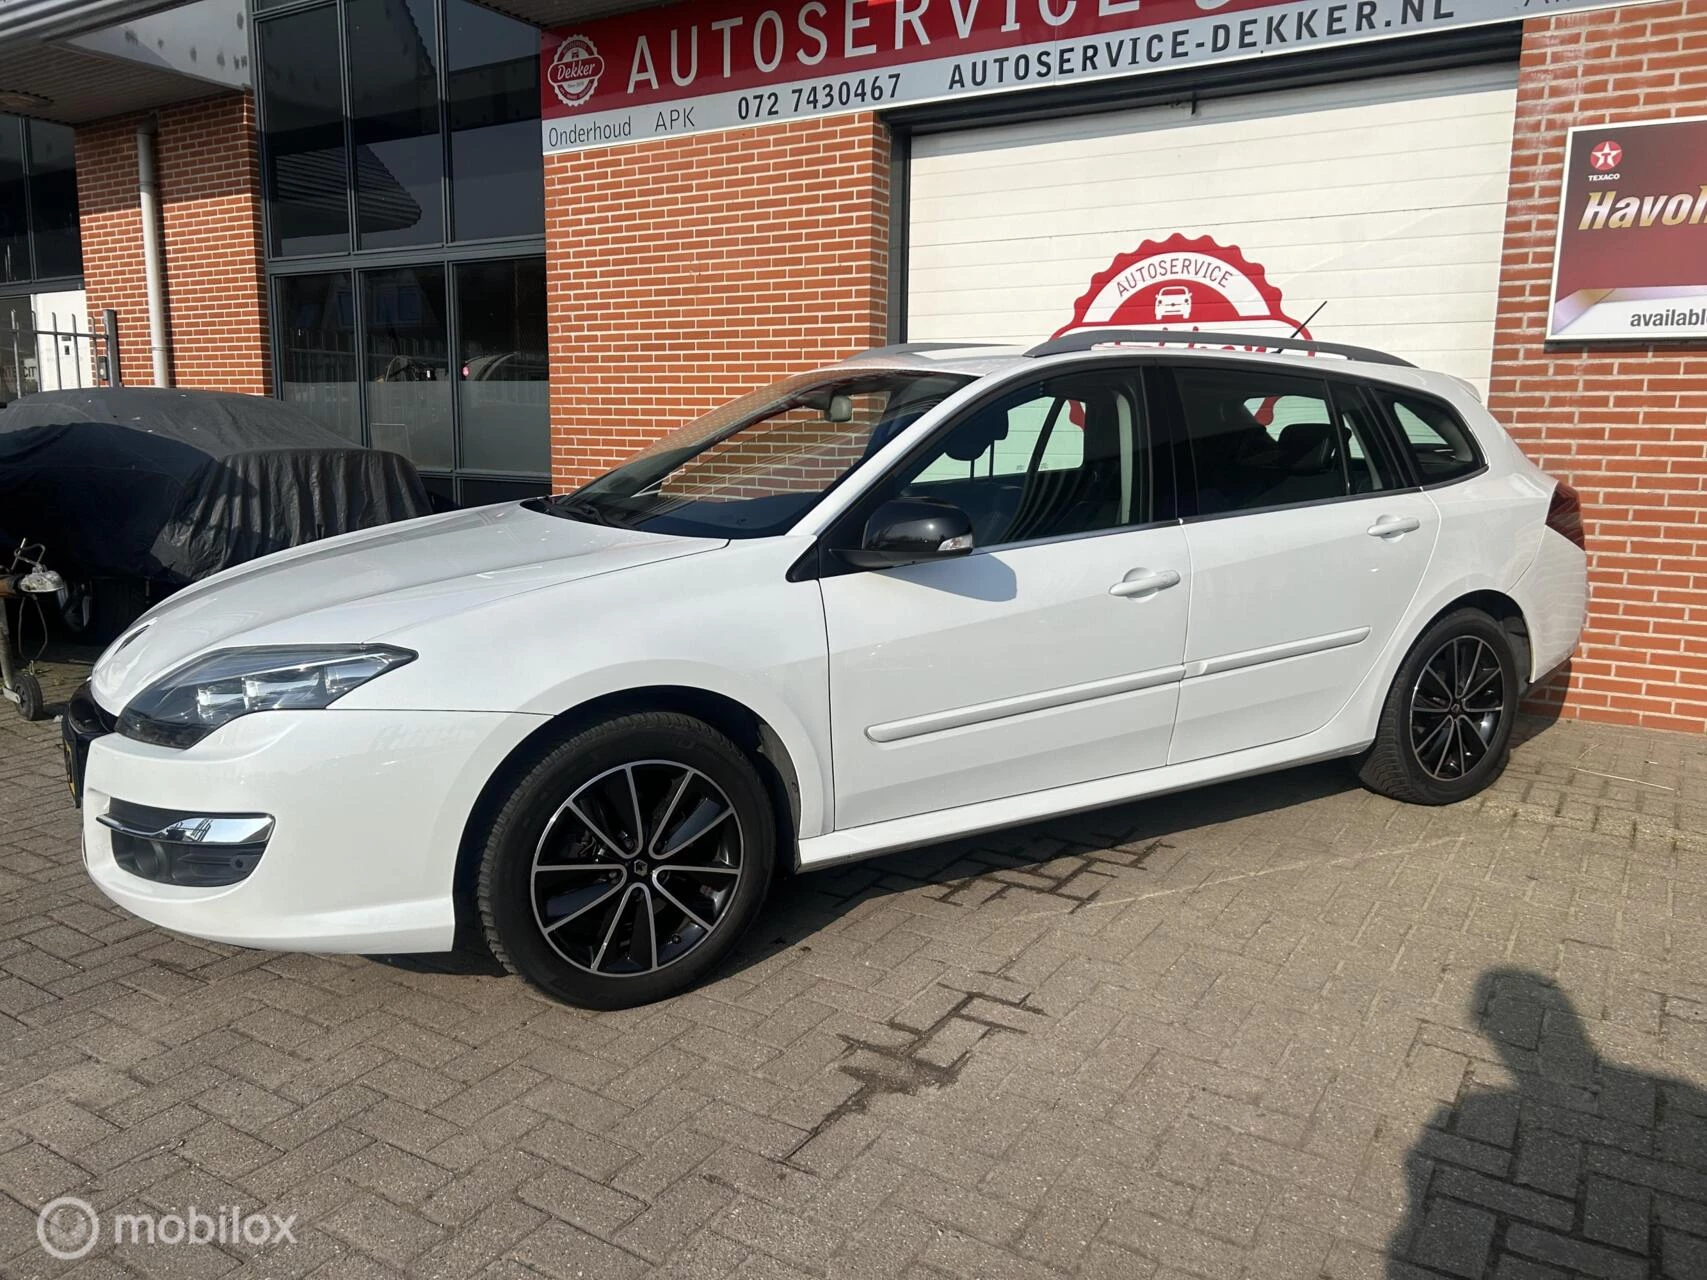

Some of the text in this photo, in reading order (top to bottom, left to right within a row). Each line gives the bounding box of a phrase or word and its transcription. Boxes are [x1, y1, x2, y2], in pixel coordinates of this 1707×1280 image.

[949, 0, 1454, 89] AUTOSERVICE-DEKKER.NL
[557, 60, 596, 80] Dekker
[738, 73, 900, 120] 072 7430467
[549, 106, 695, 147] Onderhoud APK
[1588, 173, 1620, 181] TEXACO
[1578, 185, 1707, 230] Havol
[1117, 258, 1232, 297] AUTOSERVICE
[1630, 309, 1707, 327] availabl
